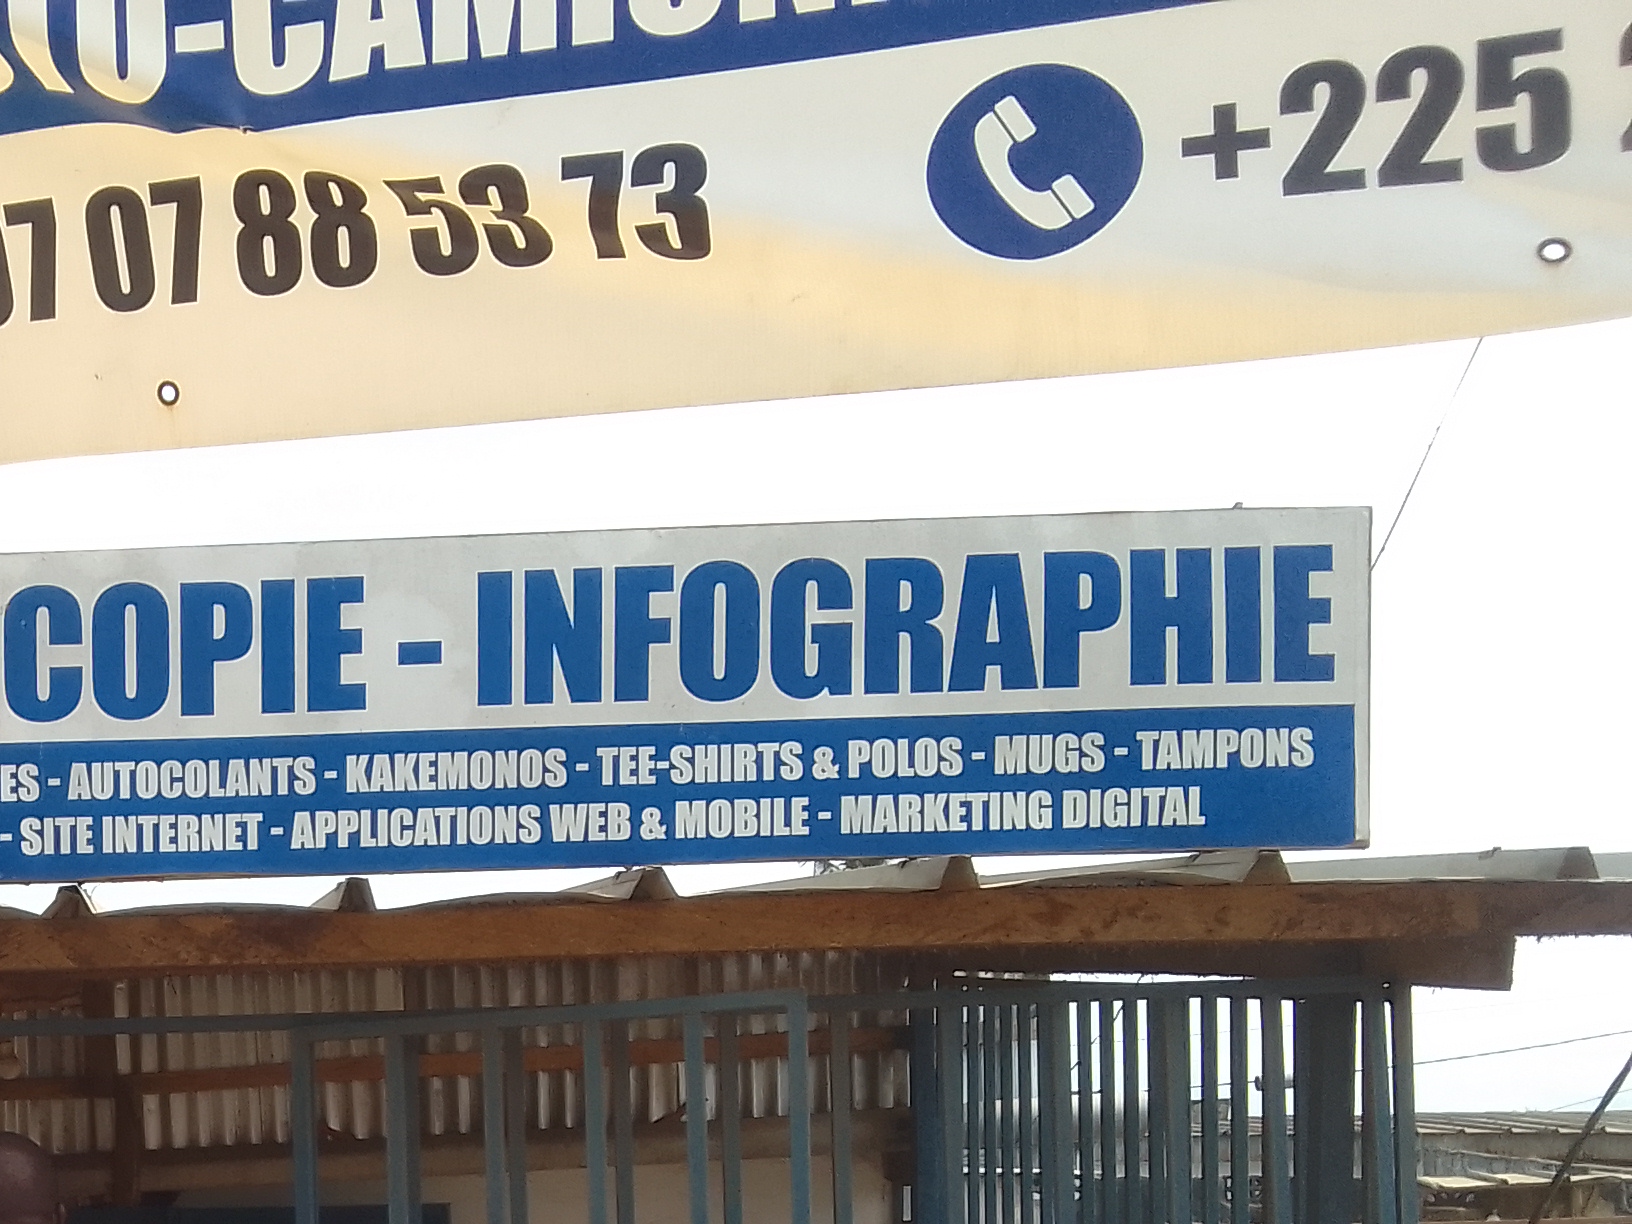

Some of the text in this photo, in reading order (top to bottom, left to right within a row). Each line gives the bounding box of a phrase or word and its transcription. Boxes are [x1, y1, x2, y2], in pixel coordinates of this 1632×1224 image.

[1180, 28, 1572, 197] +225
[85, 177, 203, 313] 07
[232, 170, 379, 297] 88
[383, 164, 554, 276] 53
[560, 143, 712, 261] 73
[477, 545, 1335, 707] INFOGRAPHIE
[18, 815, 95, 857] SITE
[101, 811, 265, 855] INTERNET
[289, 803, 543, 851] APPLICATIONS
[547, 801, 632, 844] WEB
[638, 806, 668, 842] &
[674, 795, 811, 840] MOBILE
[839, 789, 1054, 836] MARKETING
[1061, 785, 1207, 830] DIGITAL
[66, 755, 317, 802] AUTOCOLANTS
[345, 747, 568, 794] KAKEMONOS
[595, 740, 805, 787] TEE-SHIRTS
[810, 745, 841, 781] &
[846, 735, 964, 780] POLOS
[993, 731, 1106, 776] MUGS
[1135, 726, 1315, 772] TAMPONS
